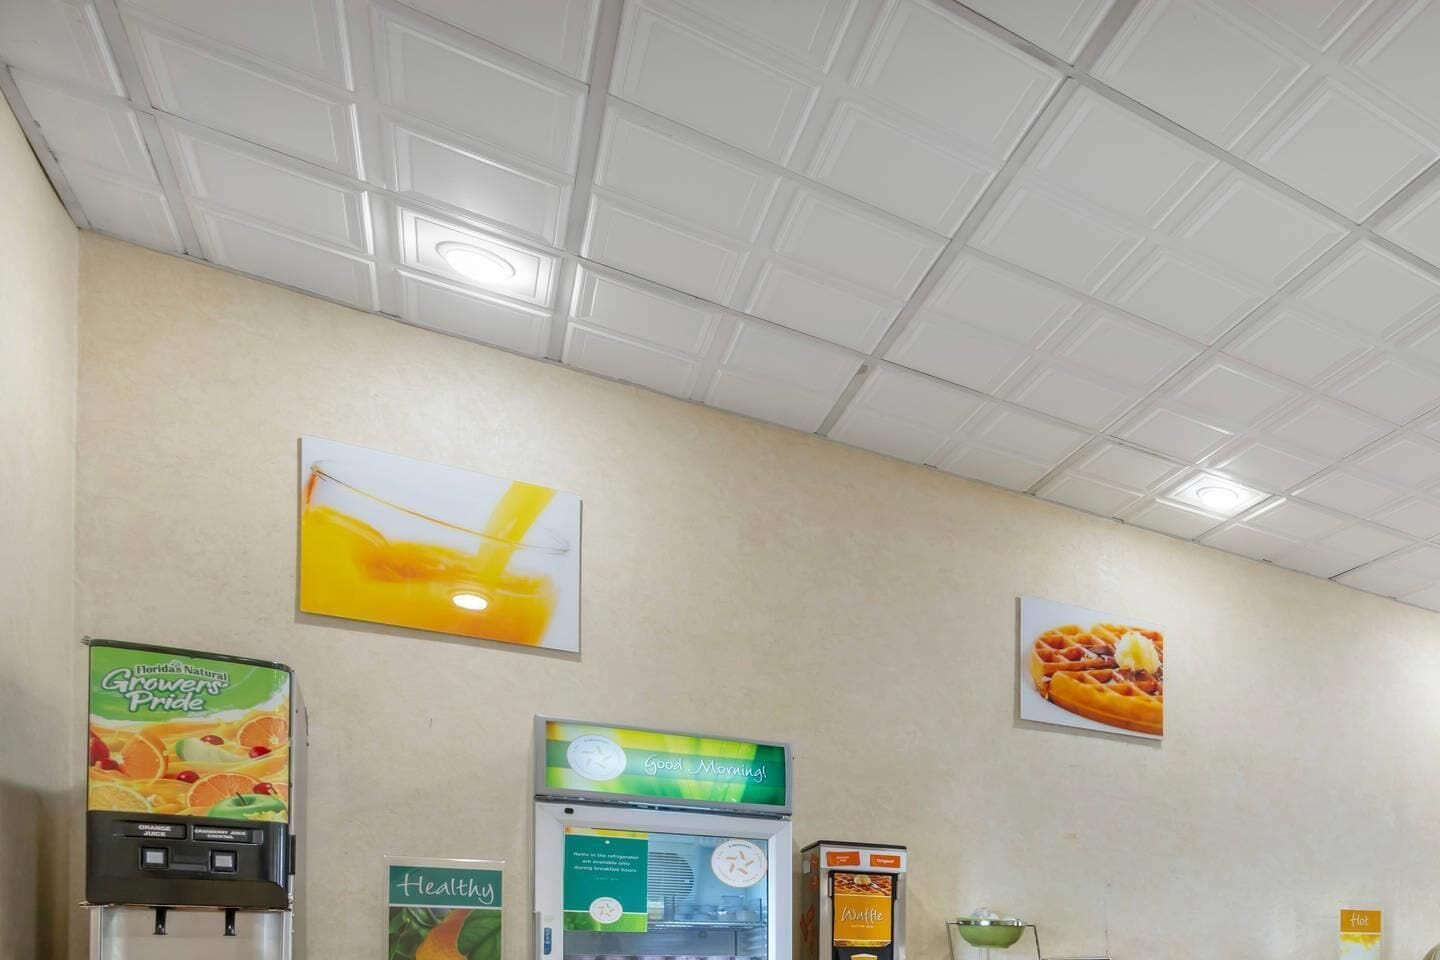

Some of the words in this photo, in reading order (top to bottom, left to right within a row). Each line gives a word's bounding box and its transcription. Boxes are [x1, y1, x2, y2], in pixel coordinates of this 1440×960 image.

[184, 665, 227, 681] Natural
[125, 690, 204, 712] Pride
[644, 753, 682, 776] Good
[688, 759, 767, 783] Morning!
[138, 824, 172, 832] ORANGE
[396, 873, 494, 905] Healthy
[841, 905, 884, 924] Waffle
[1350, 911, 1369, 928] Hot
